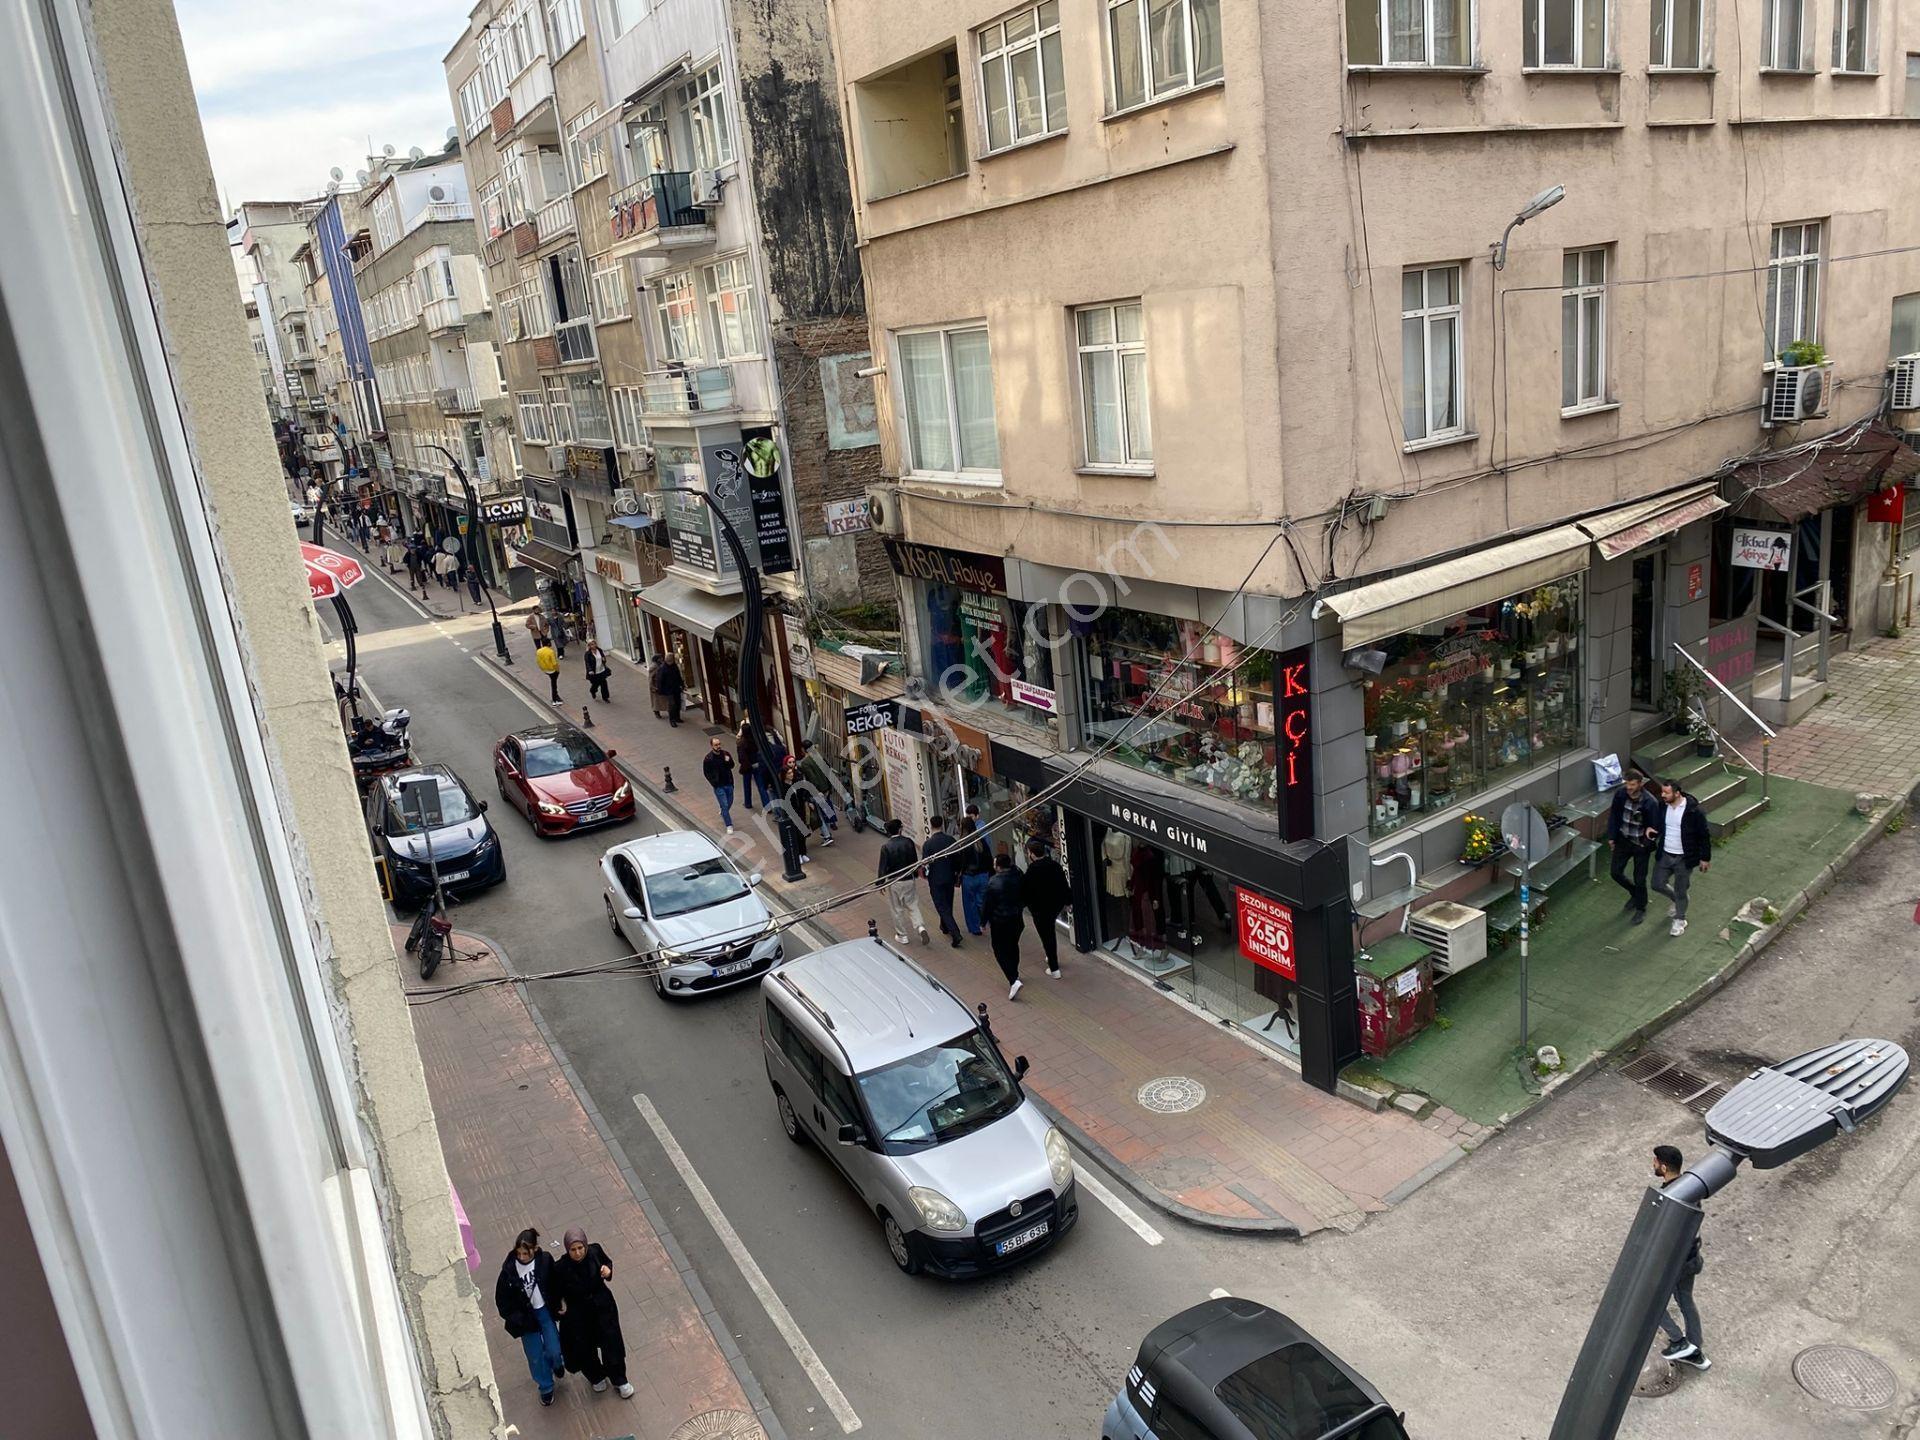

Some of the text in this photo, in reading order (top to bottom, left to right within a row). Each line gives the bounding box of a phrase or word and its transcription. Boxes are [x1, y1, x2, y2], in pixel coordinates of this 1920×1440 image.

[761, 520, 780, 528] LAZER
[831, 514, 871, 534] REK
[859, 703, 878, 714] FOTO
[846, 711, 893, 734] REKOR
[1111, 803, 1208, 853] M@RKA GİYİM
[1239, 892, 1269, 912] SEZON
[1246, 915, 1290, 952] %50
[1248, 935, 1292, 968] İNDİRİM
